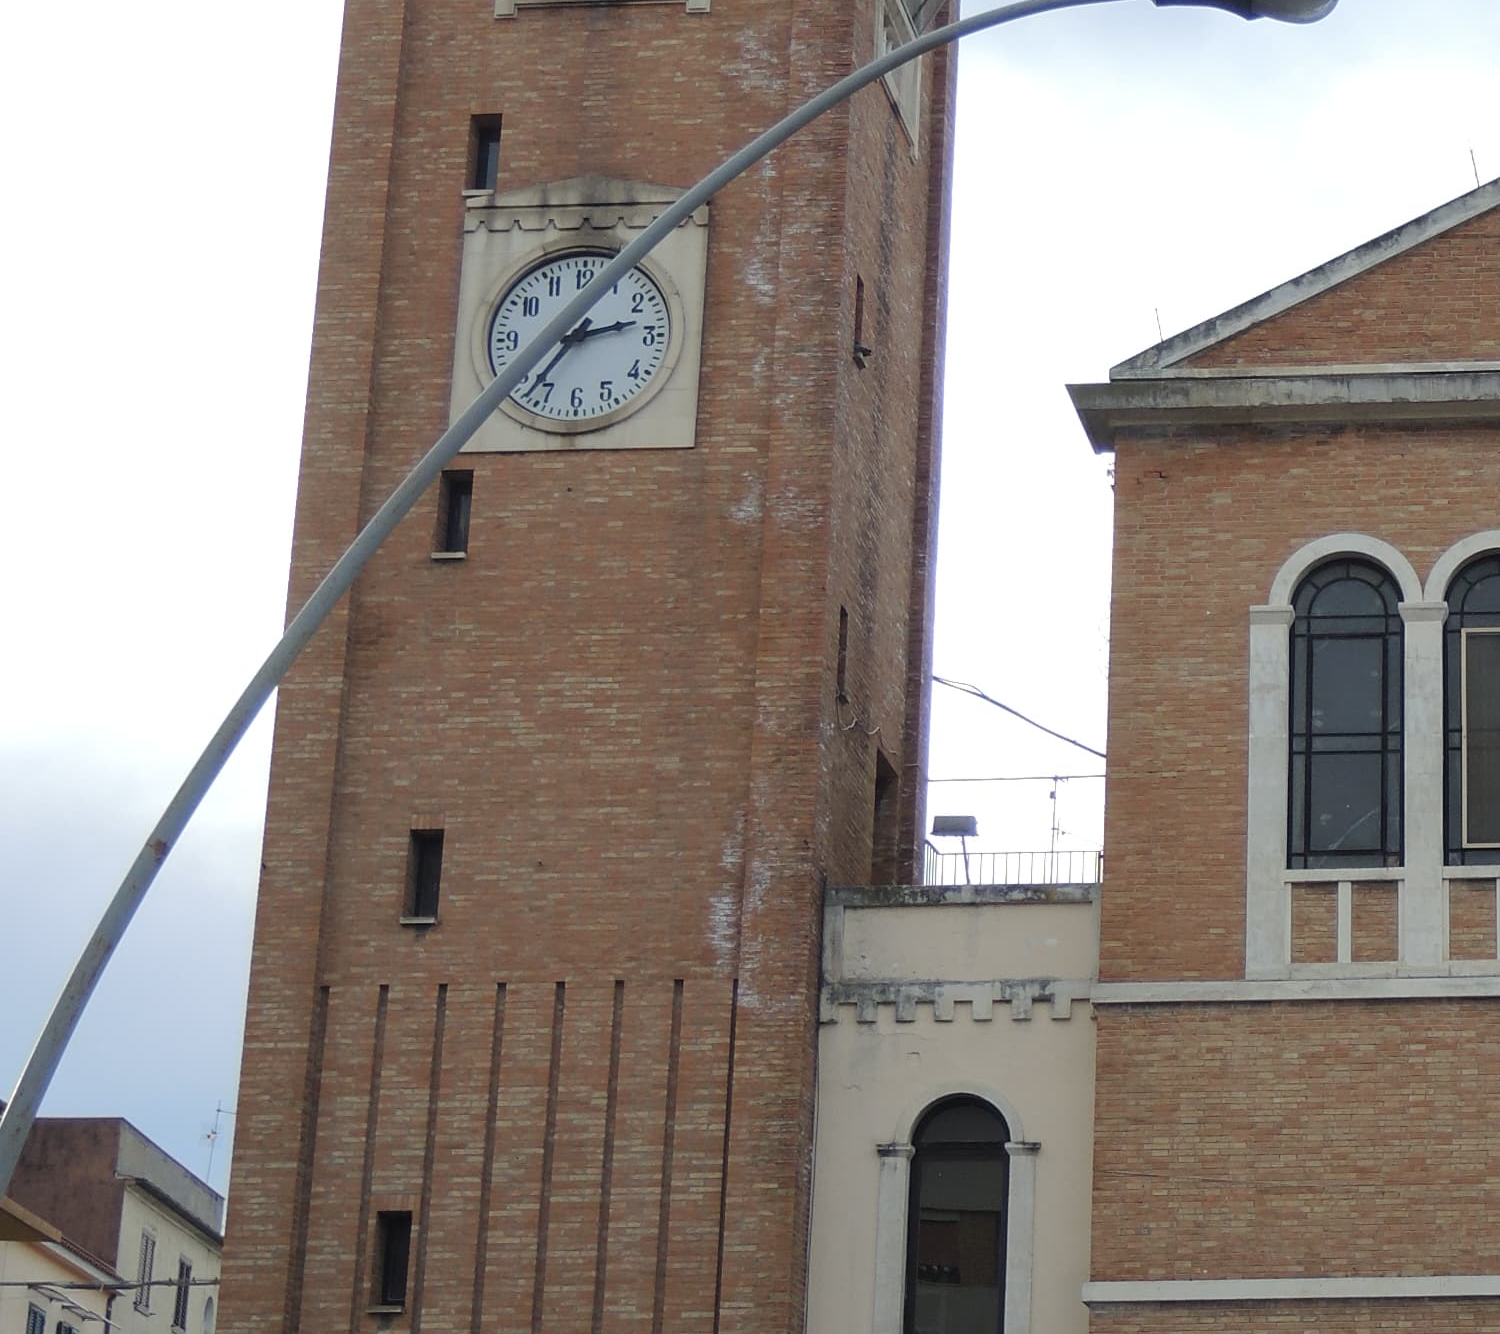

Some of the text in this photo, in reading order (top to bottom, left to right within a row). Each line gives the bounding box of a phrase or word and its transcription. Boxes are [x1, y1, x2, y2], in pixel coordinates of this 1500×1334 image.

[549, 275, 560, 297] 11
[576, 269, 594, 290] 12
[522, 296, 539, 317] 10
[632, 292, 643, 313] 2
[506, 331, 519, 351] 9
[643, 325, 655, 347] 3
[627, 359, 640, 380] 4
[542, 383, 554, 403] 7
[571, 388, 583, 408] 6
[600, 381, 612, 402] 5
